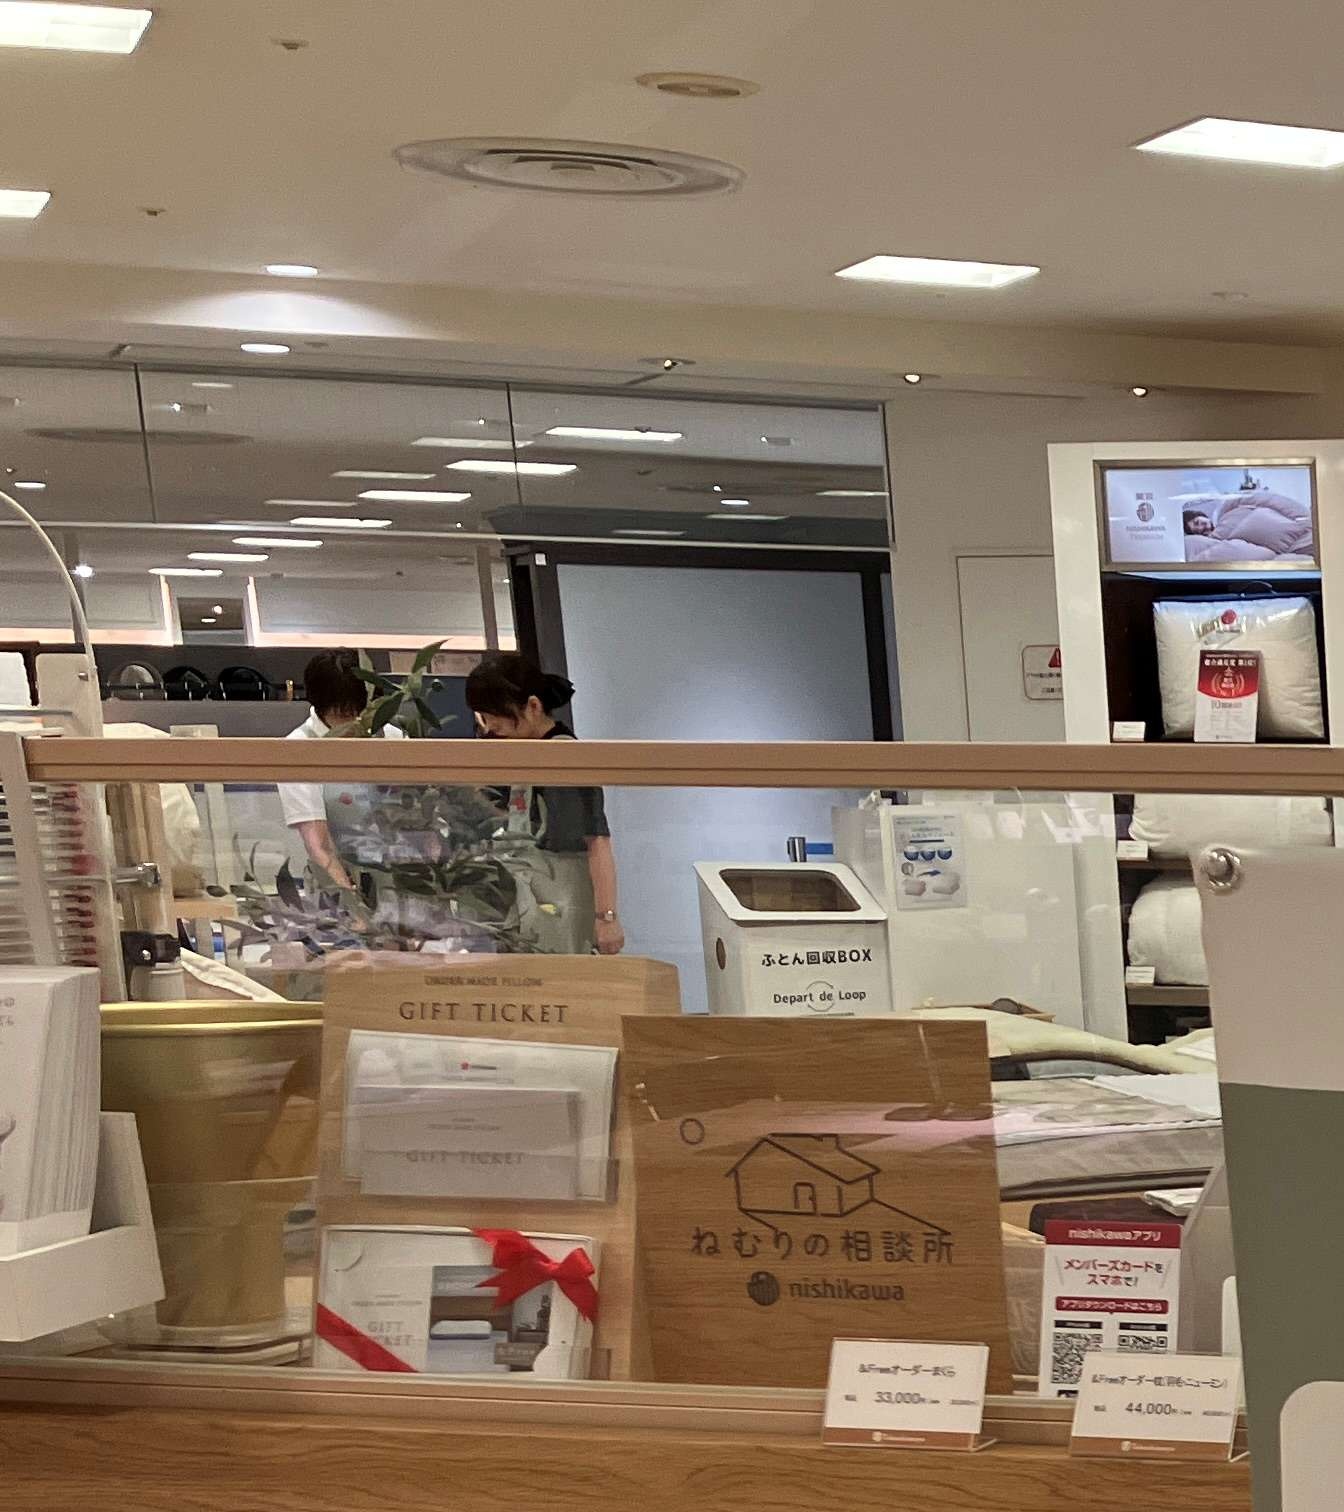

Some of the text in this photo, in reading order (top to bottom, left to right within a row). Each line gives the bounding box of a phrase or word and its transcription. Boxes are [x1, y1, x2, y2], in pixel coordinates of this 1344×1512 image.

[761, 949, 872, 967] ふとん回収BOX
[773, 990, 867, 1005] Depart de Loop
[400, 1002, 569, 1023] GIFT TICKET
[691, 1227, 955, 1264] ねむりの相談所
[789, 1276, 905, 1301] nishikawa
